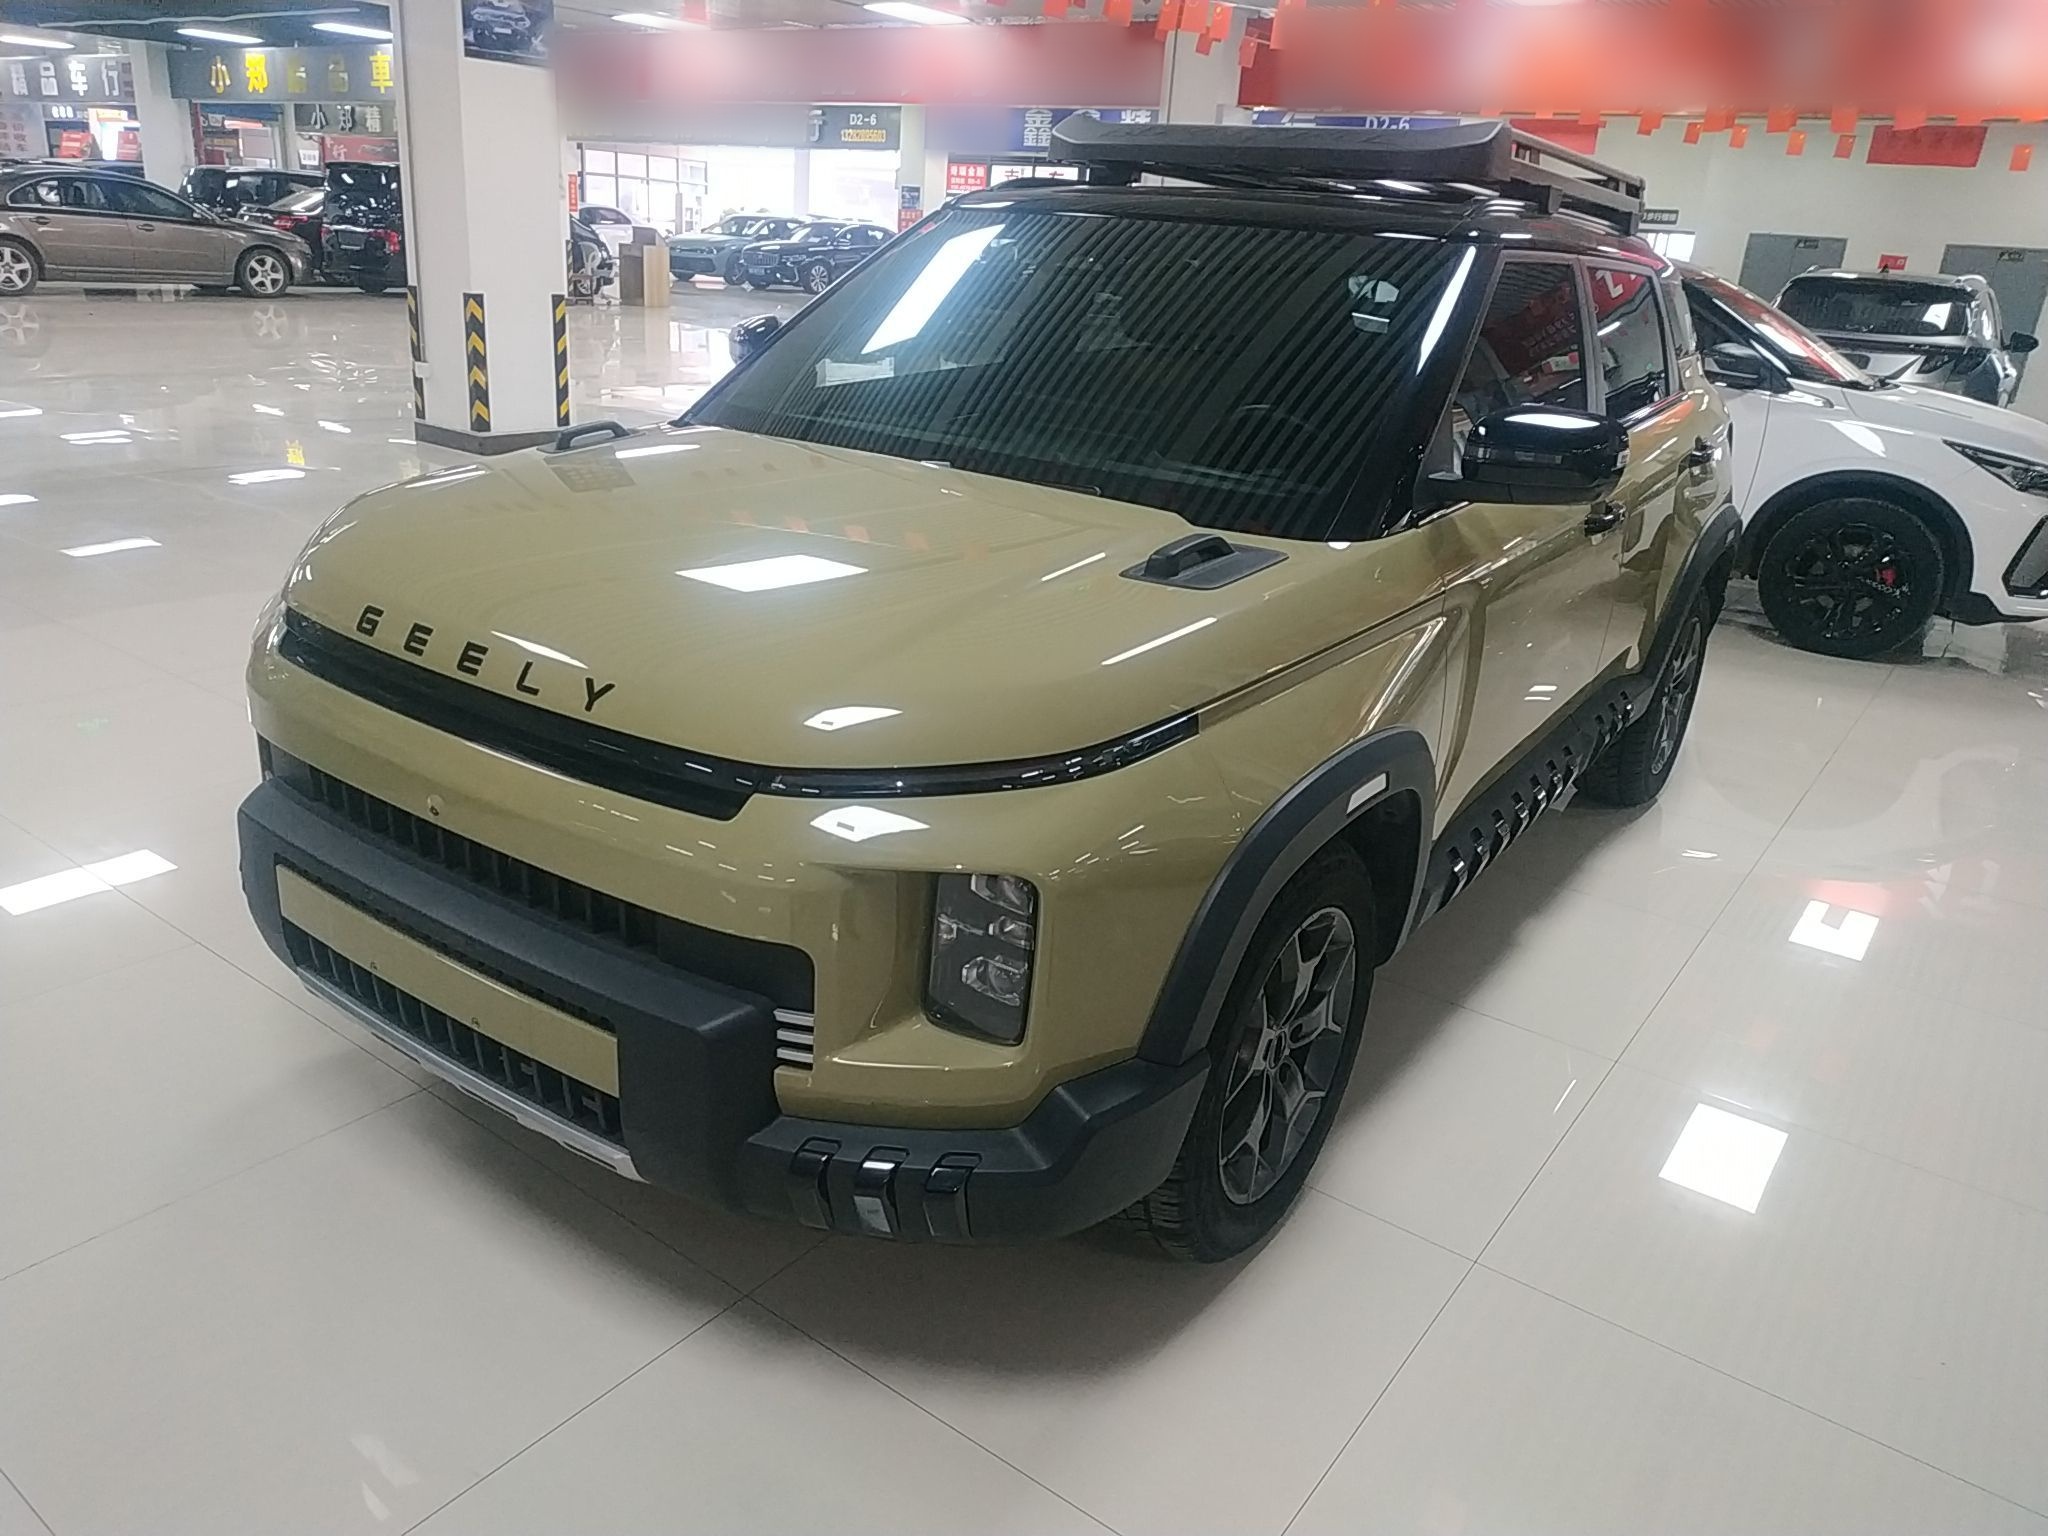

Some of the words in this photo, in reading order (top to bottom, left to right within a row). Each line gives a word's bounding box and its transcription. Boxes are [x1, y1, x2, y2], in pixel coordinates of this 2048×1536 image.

[310, 104, 397, 133] 小郑精
[849, 113, 877, 125] D2-6
[357, 604, 616, 712] GEELY
